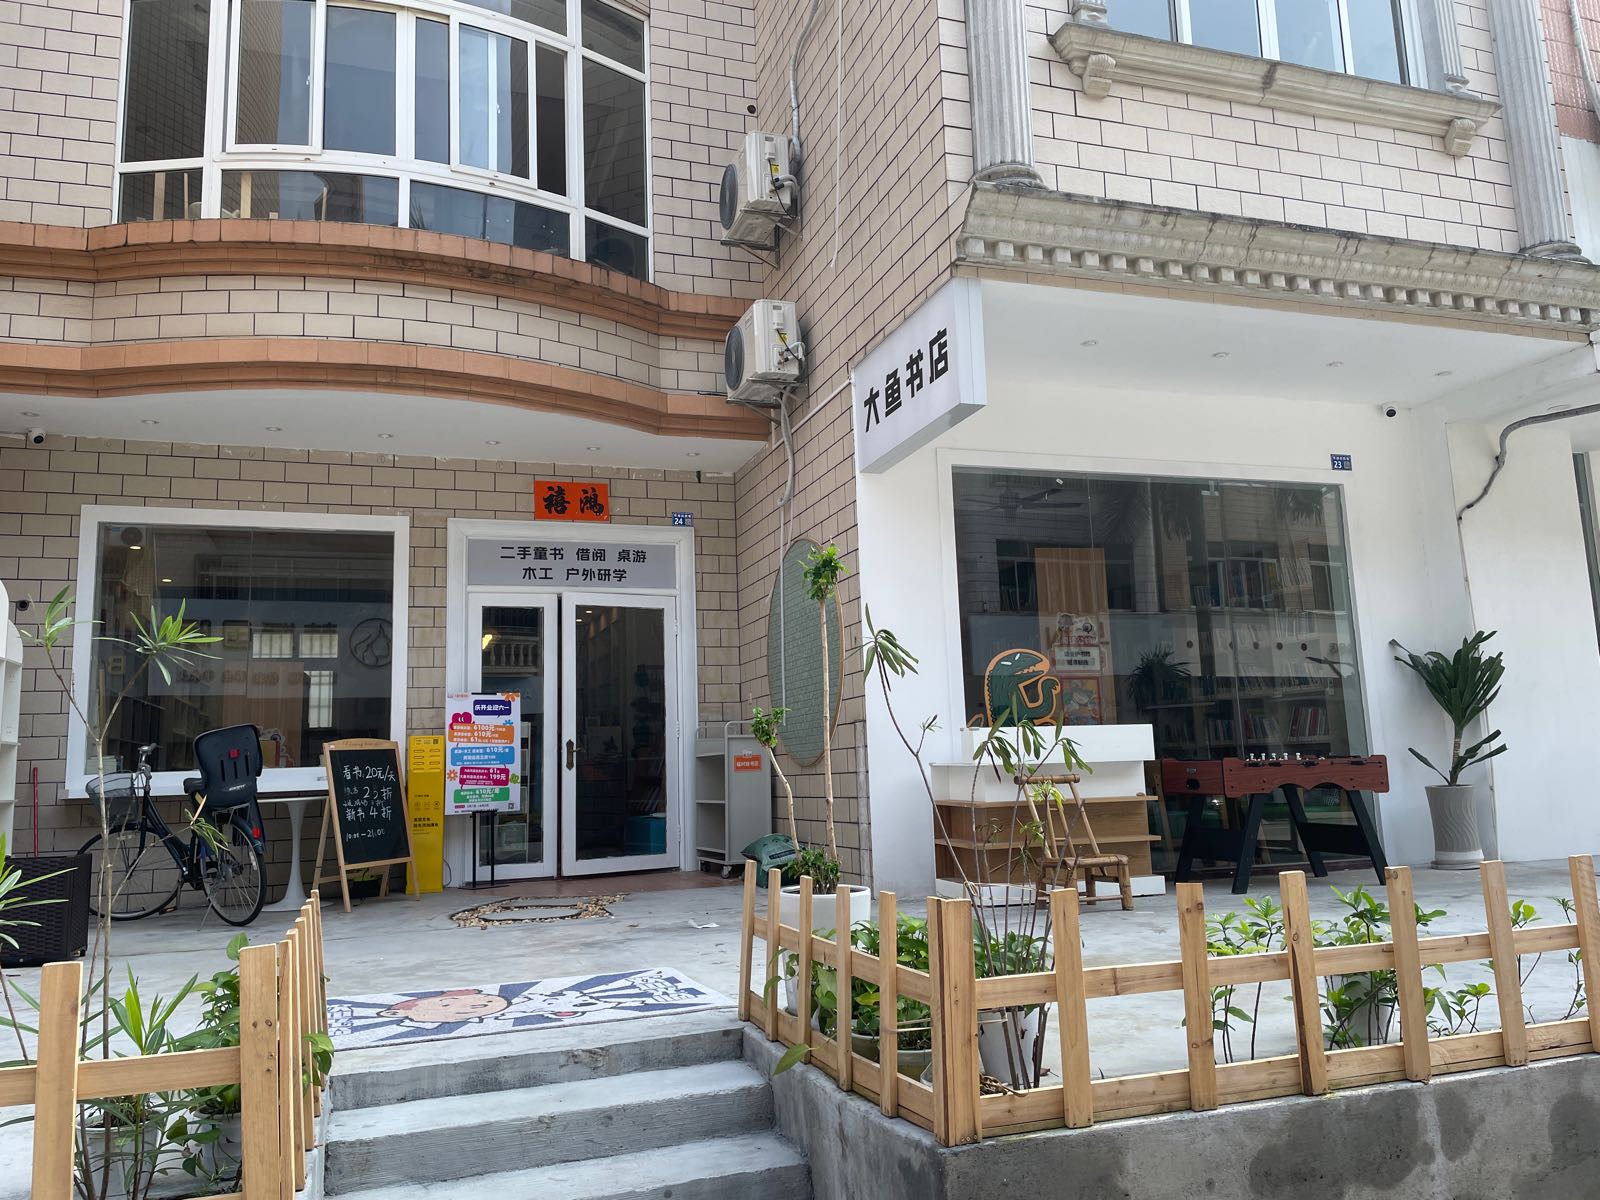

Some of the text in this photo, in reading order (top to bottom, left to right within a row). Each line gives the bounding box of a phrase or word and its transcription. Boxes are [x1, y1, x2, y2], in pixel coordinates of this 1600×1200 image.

[863, 327, 949, 433] 大鱼书店
[1334, 460, 1342, 469] 23
[674, 517, 683, 525] 24
[500, 545, 647, 564] 二手童书 借阅 桌游
[522, 567, 627, 582] 木工 户外研学
